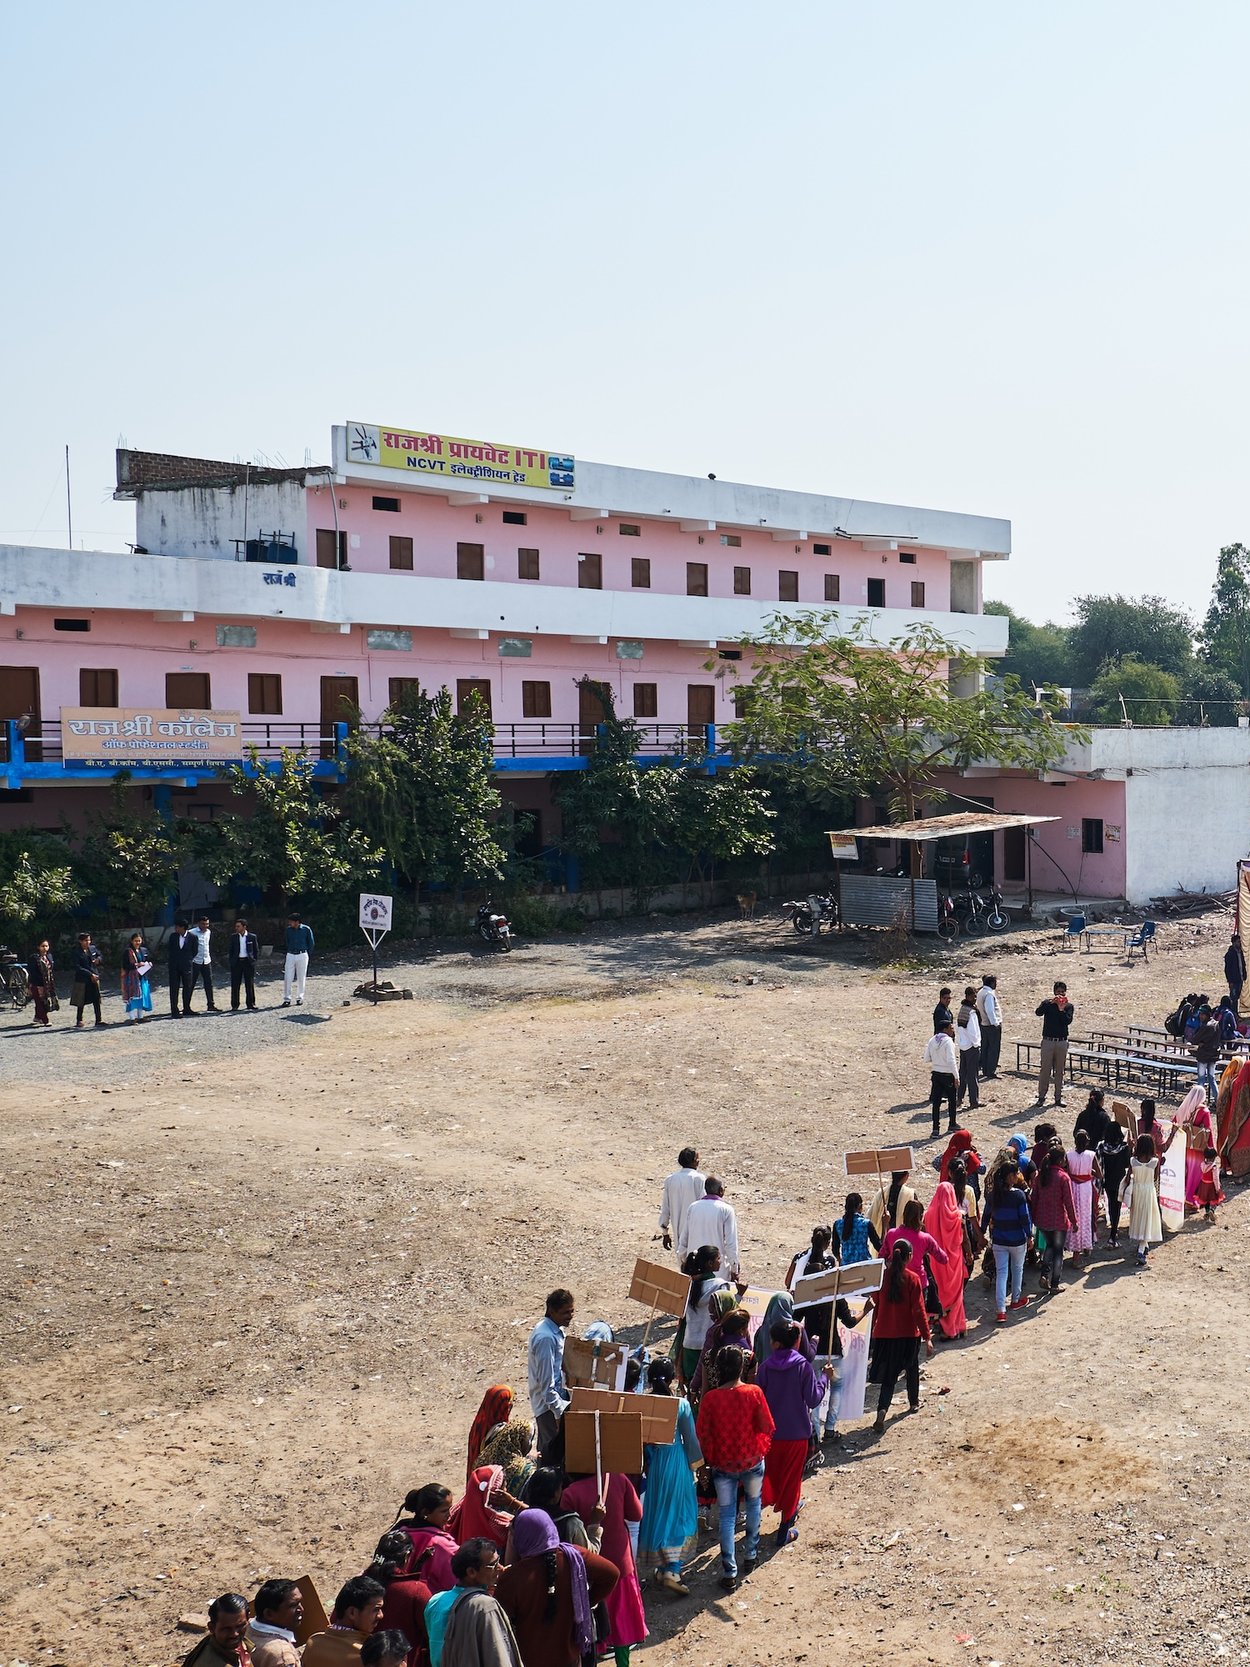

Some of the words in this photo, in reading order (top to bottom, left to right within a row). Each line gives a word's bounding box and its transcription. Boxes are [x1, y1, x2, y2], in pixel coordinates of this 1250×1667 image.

[383, 431, 443, 455] राजश्री
[448, 442, 510, 464] प्रायवेट
[515, 450, 546, 469] ITI
[406, 456, 446, 471] NCVT
[511, 470, 526, 483] ट्रेड
[68, 714, 153, 737] राजश्री
[156, 715, 237, 737] कॉलेज
[102, 738, 127, 749] ऑफ
[127, 739, 177, 751] प्रोफेशनल
